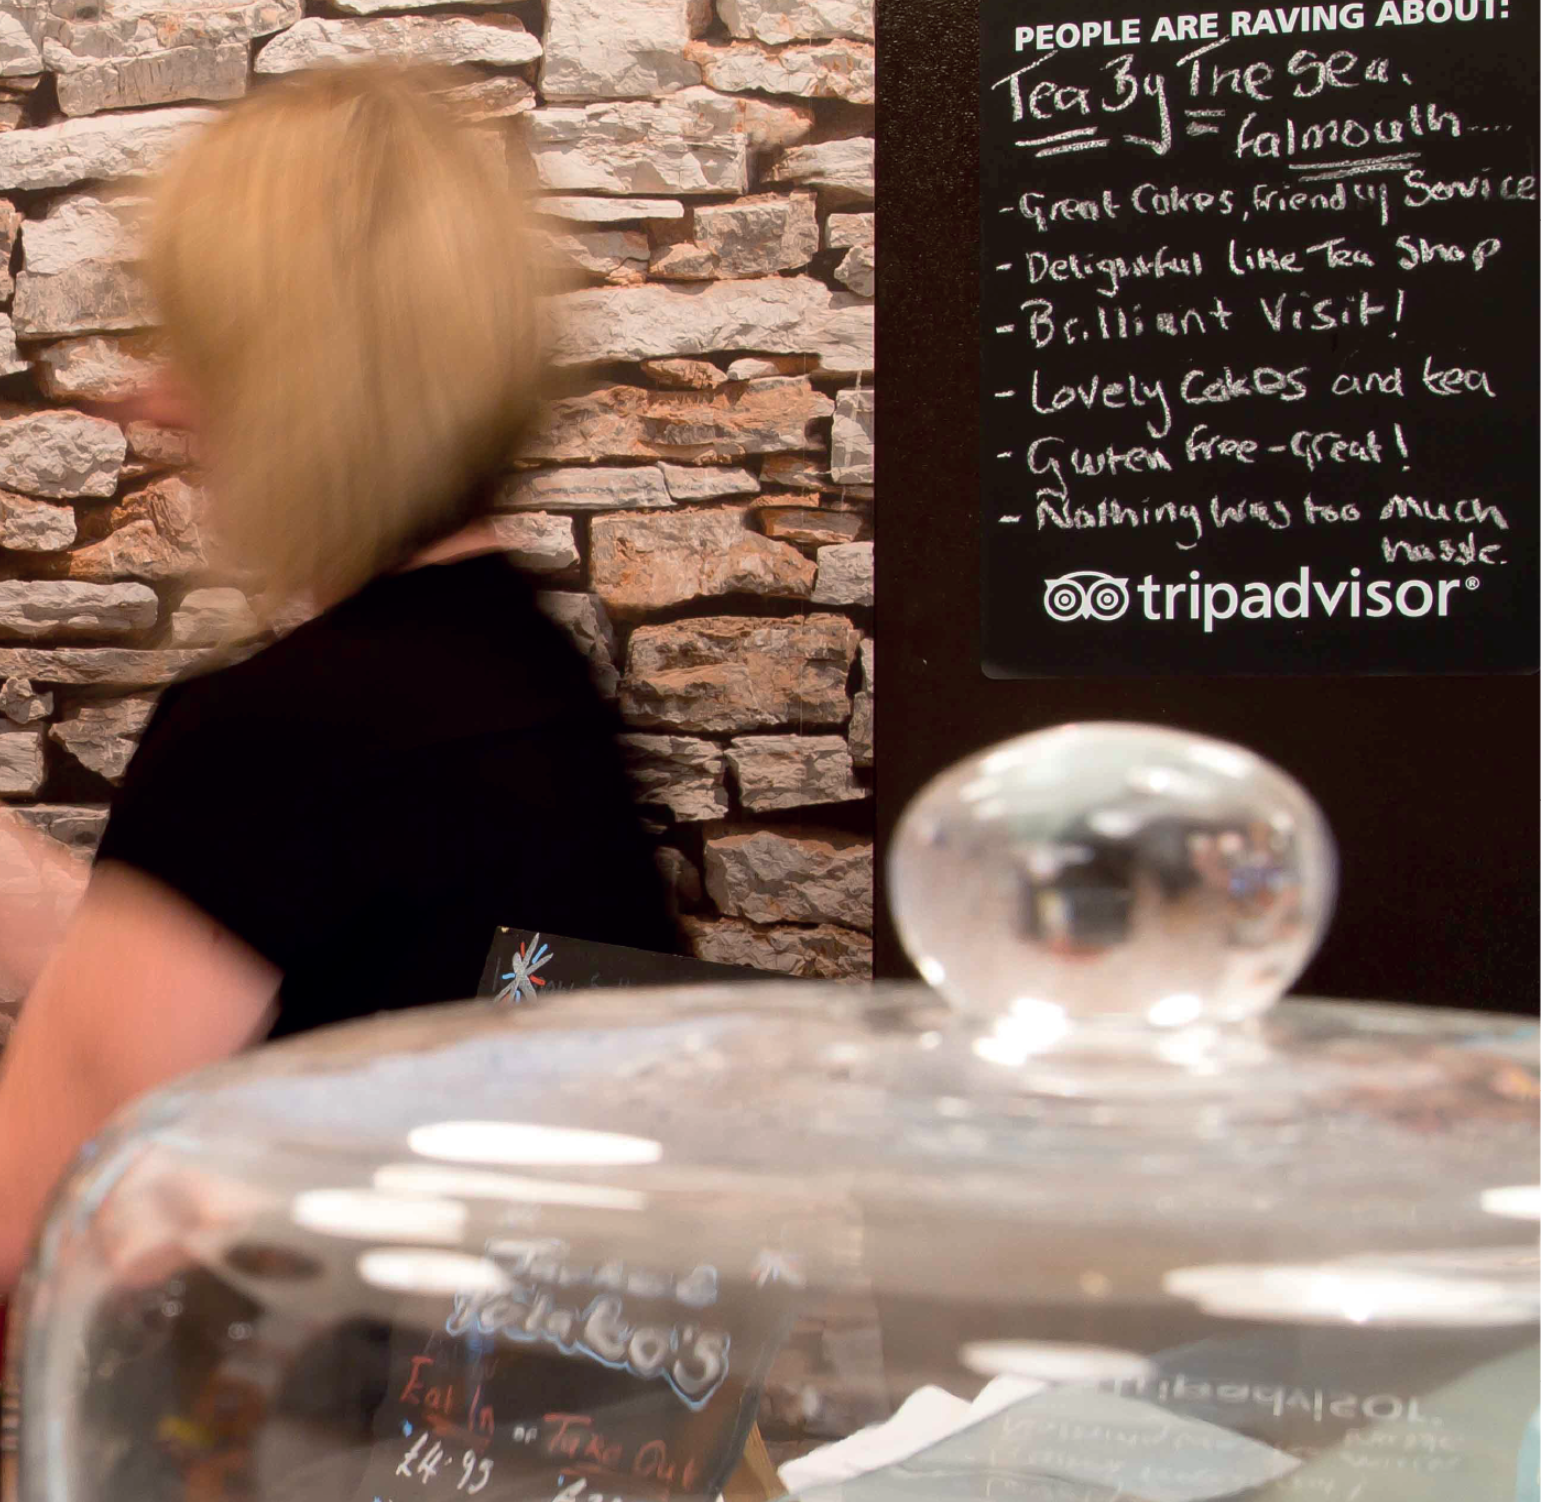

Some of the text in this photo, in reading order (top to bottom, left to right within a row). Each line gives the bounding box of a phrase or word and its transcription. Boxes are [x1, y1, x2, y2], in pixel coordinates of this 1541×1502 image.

[1015, 0, 1508, 51] PEOPLE ARE RAVING ABOUT:
[991, 50, 1090, 121] Tea
[1020, 191, 1120, 231] Great
[1306, 238, 1374, 268] Tea
[1021, 290, 1404, 348] Brilliant Visit!
[1032, 370, 1171, 438] Lovely
[1332, 368, 1403, 396] and
[1036, 497, 1202, 550] Nothing
[1304, 495, 1360, 523] too
